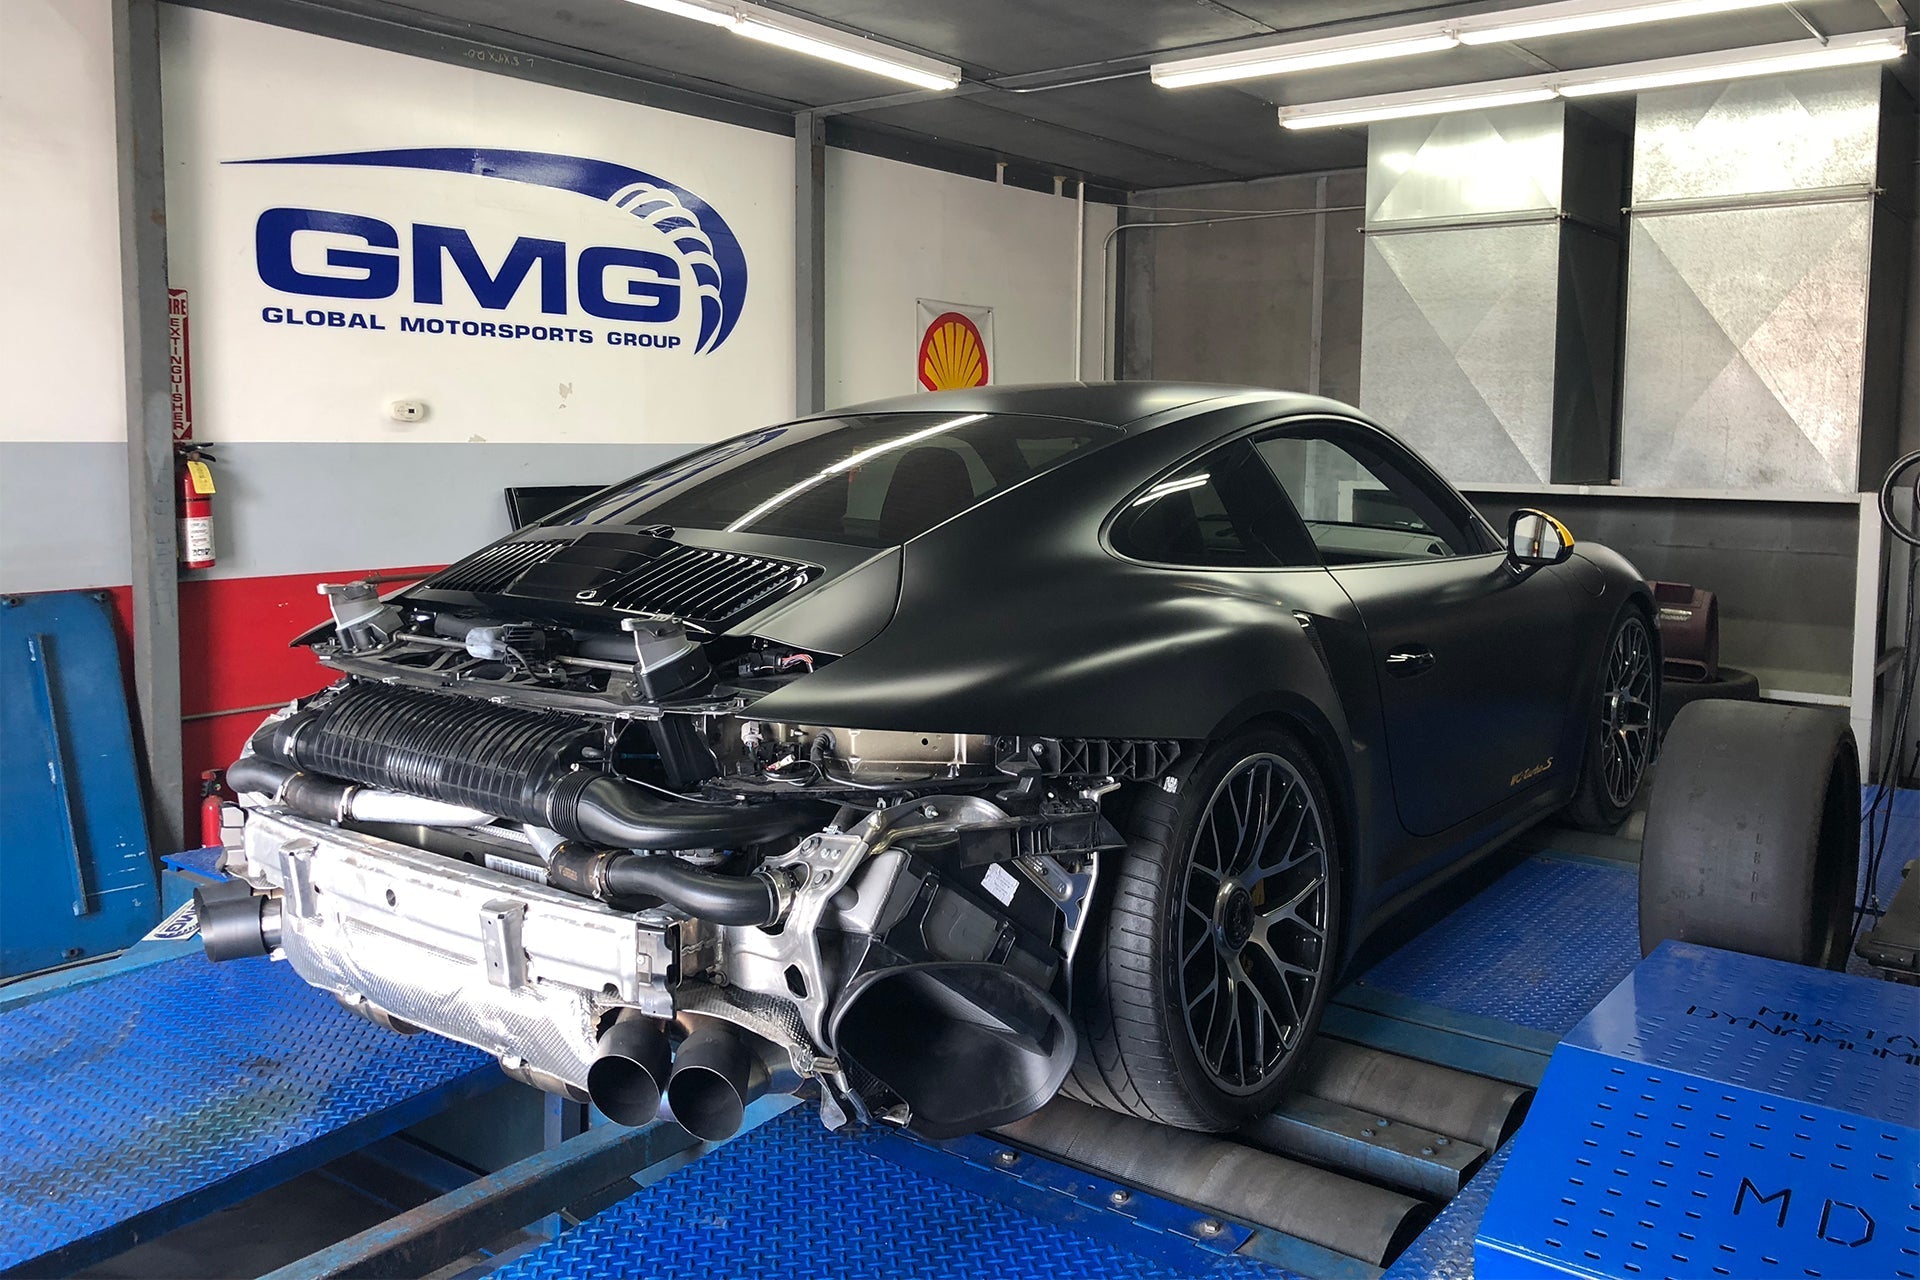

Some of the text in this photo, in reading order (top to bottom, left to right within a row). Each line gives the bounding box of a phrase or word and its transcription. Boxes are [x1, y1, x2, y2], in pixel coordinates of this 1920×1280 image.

[255, 206, 681, 323] GMG
[168, 298, 187, 315] IRE
[261, 306, 682, 349] GLOBAL MOTORSPORTS GROUP
[169, 317, 185, 431] EXTINGUISHER
